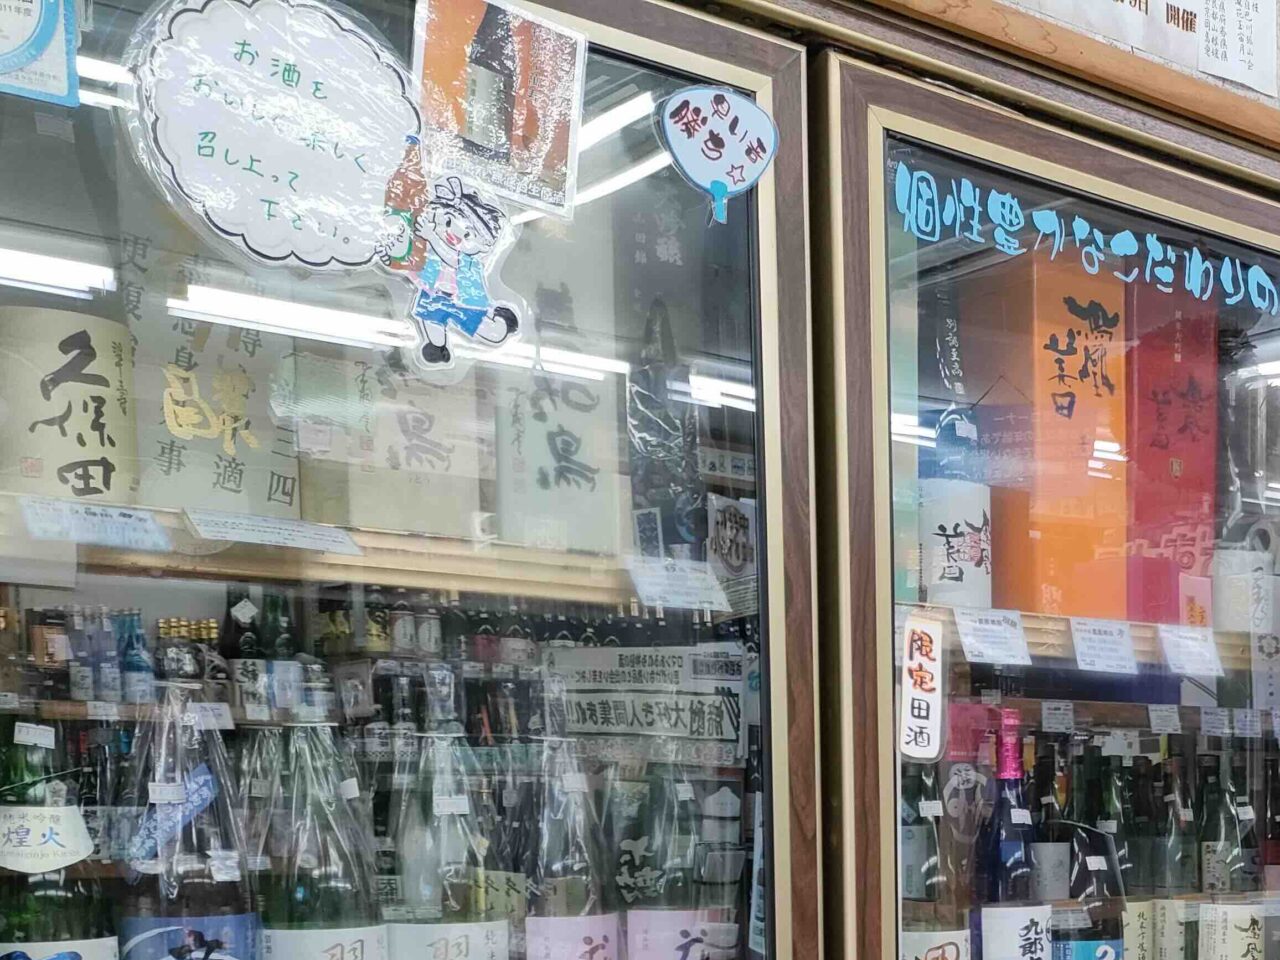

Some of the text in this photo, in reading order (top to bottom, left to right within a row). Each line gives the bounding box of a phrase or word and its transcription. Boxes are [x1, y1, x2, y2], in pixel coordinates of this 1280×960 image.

[233, 40, 328, 101] お酒を
[197, 131, 301, 192] 召し上って
[28, 329, 116, 497] 久保田
[2, 824, 67, 848] 煌火
